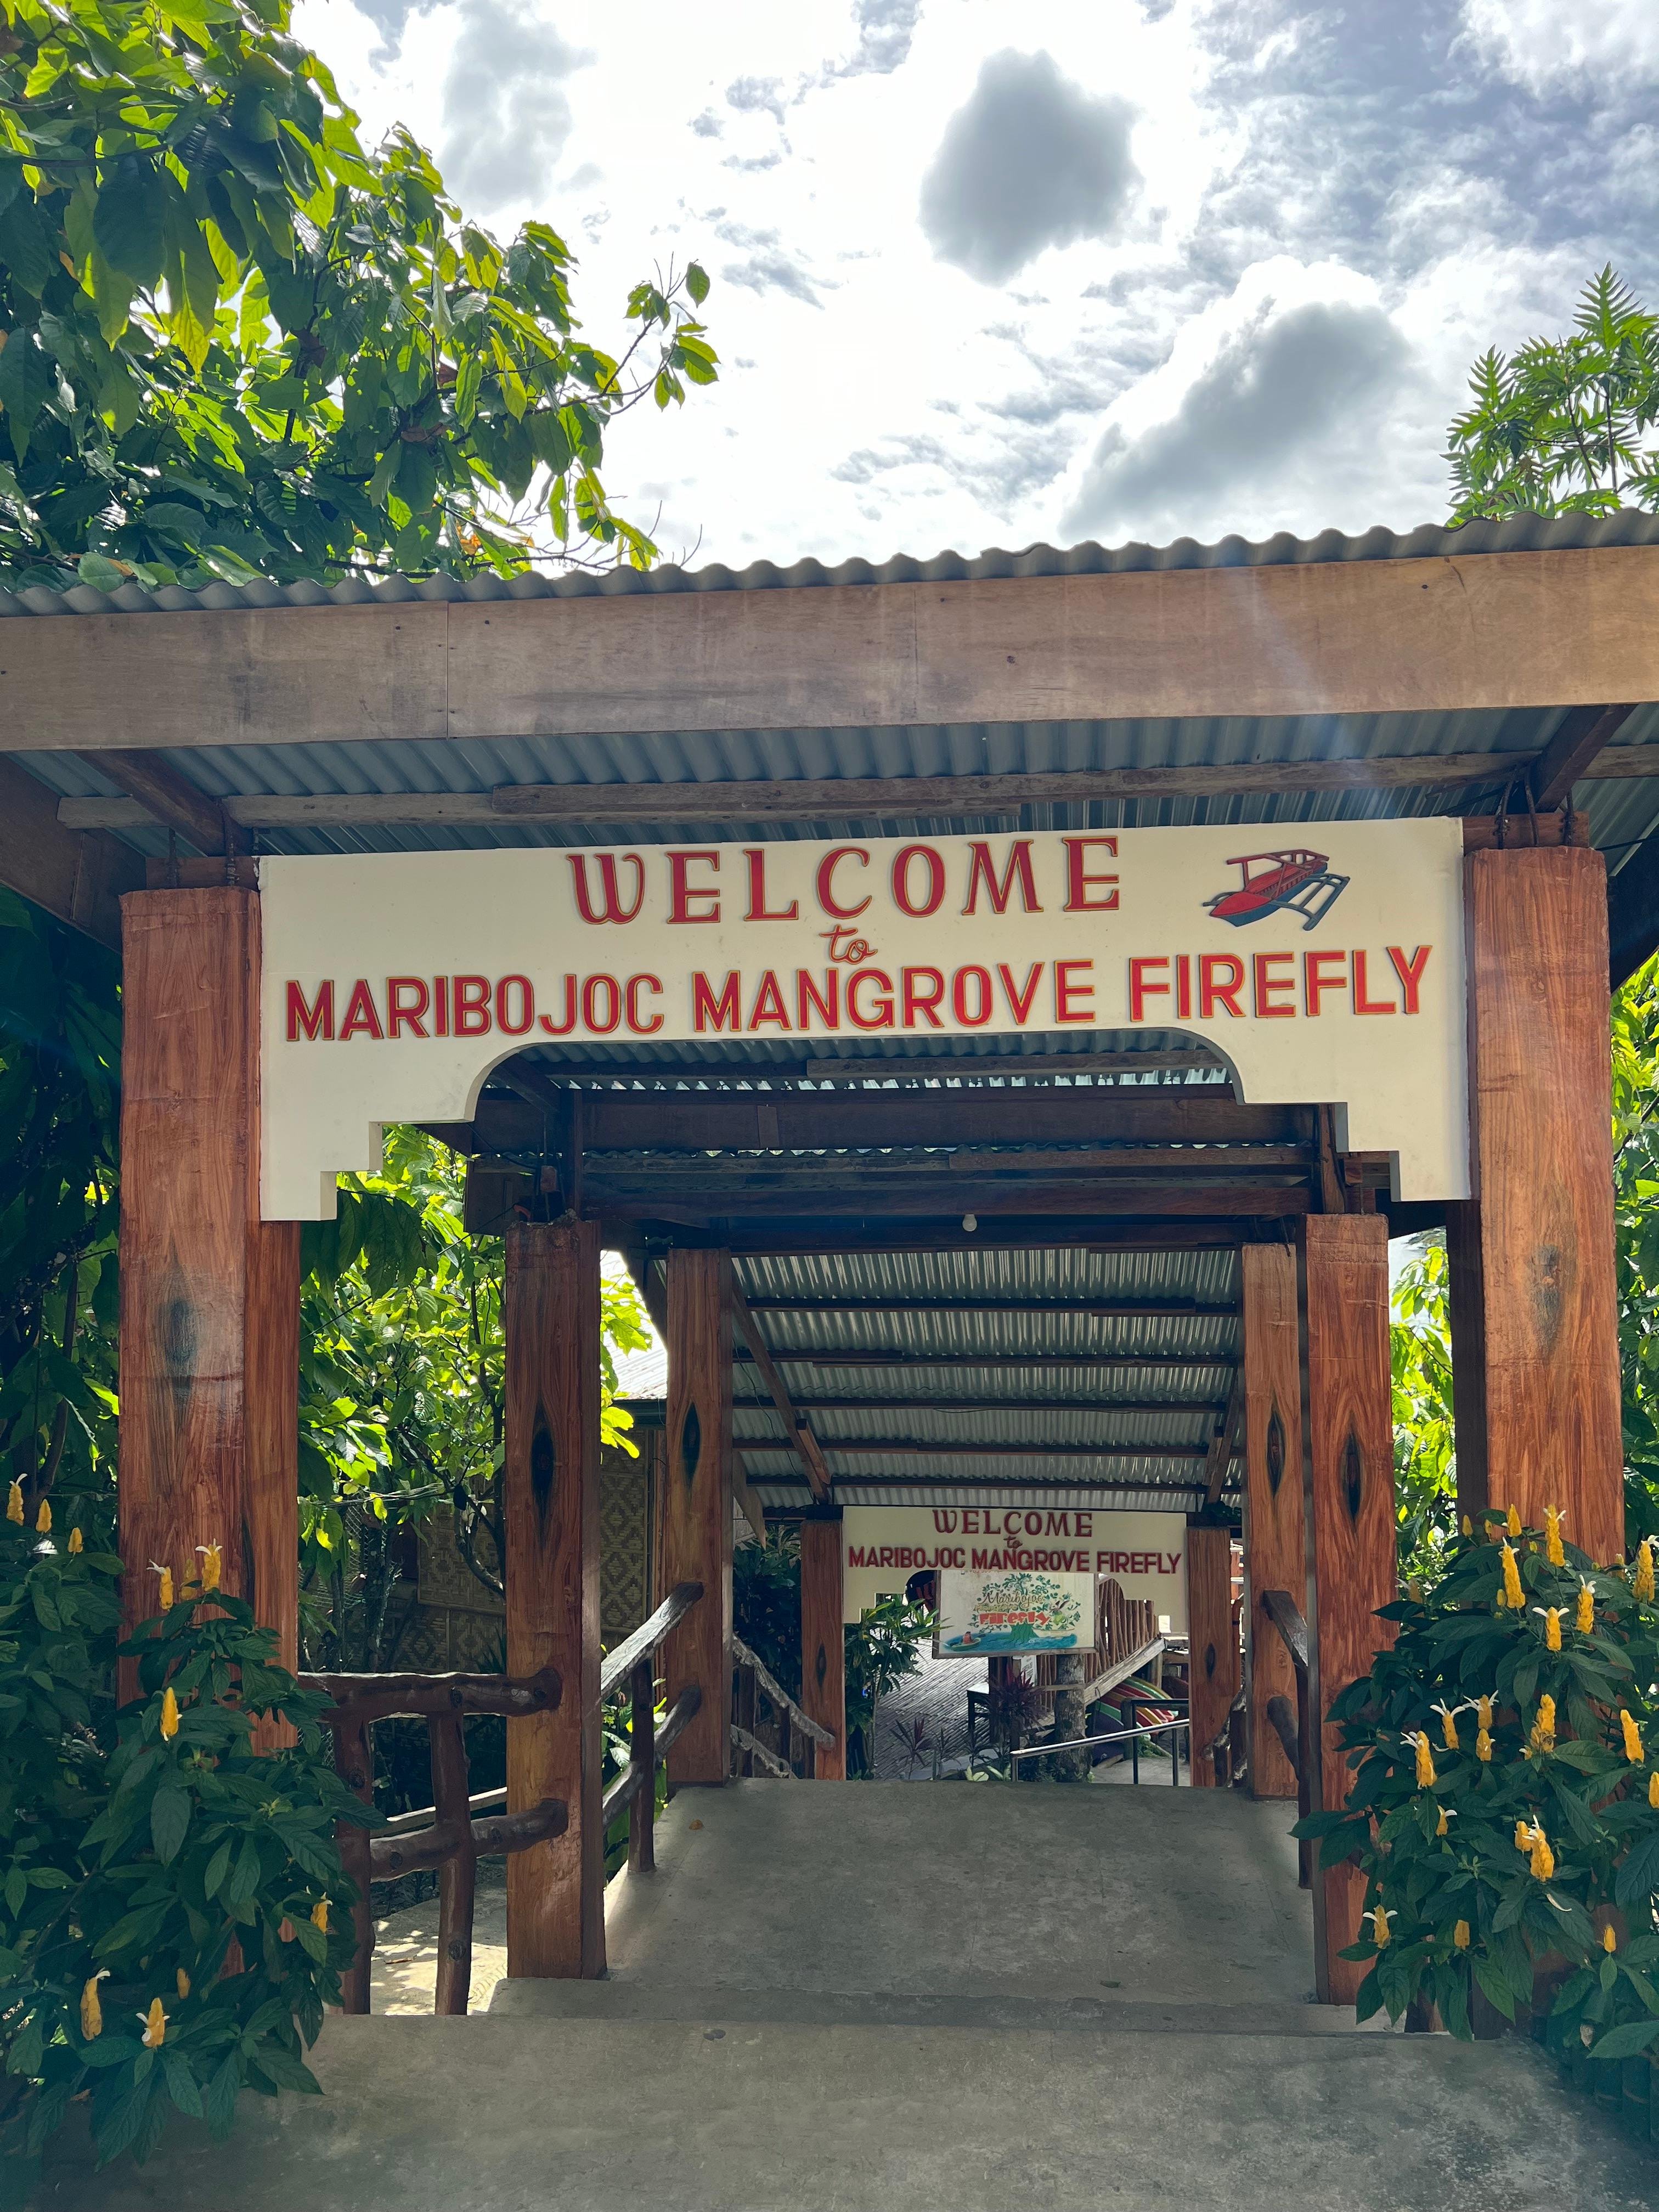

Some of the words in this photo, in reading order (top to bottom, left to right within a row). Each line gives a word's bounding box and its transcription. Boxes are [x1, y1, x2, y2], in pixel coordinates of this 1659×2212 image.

[566, 836, 1120, 926] WELCOME
[818, 924, 878, 964] to
[285, 973, 665, 1041] MARIBOJOC
[691, 958, 1096, 1033] MANGROVE
[1128, 945, 1433, 1023] FIREFLY
[932, 1509, 1092, 1537] WELCOME
[1003, 1536, 1023, 1549] to
[848, 1545, 966, 1568] MARIBOJOC
[971, 1548, 1090, 1572] MANGROVE
[1097, 1551, 1182, 1575] FIREFLY
[979, 1589, 1045, 1608] Maribojoc
